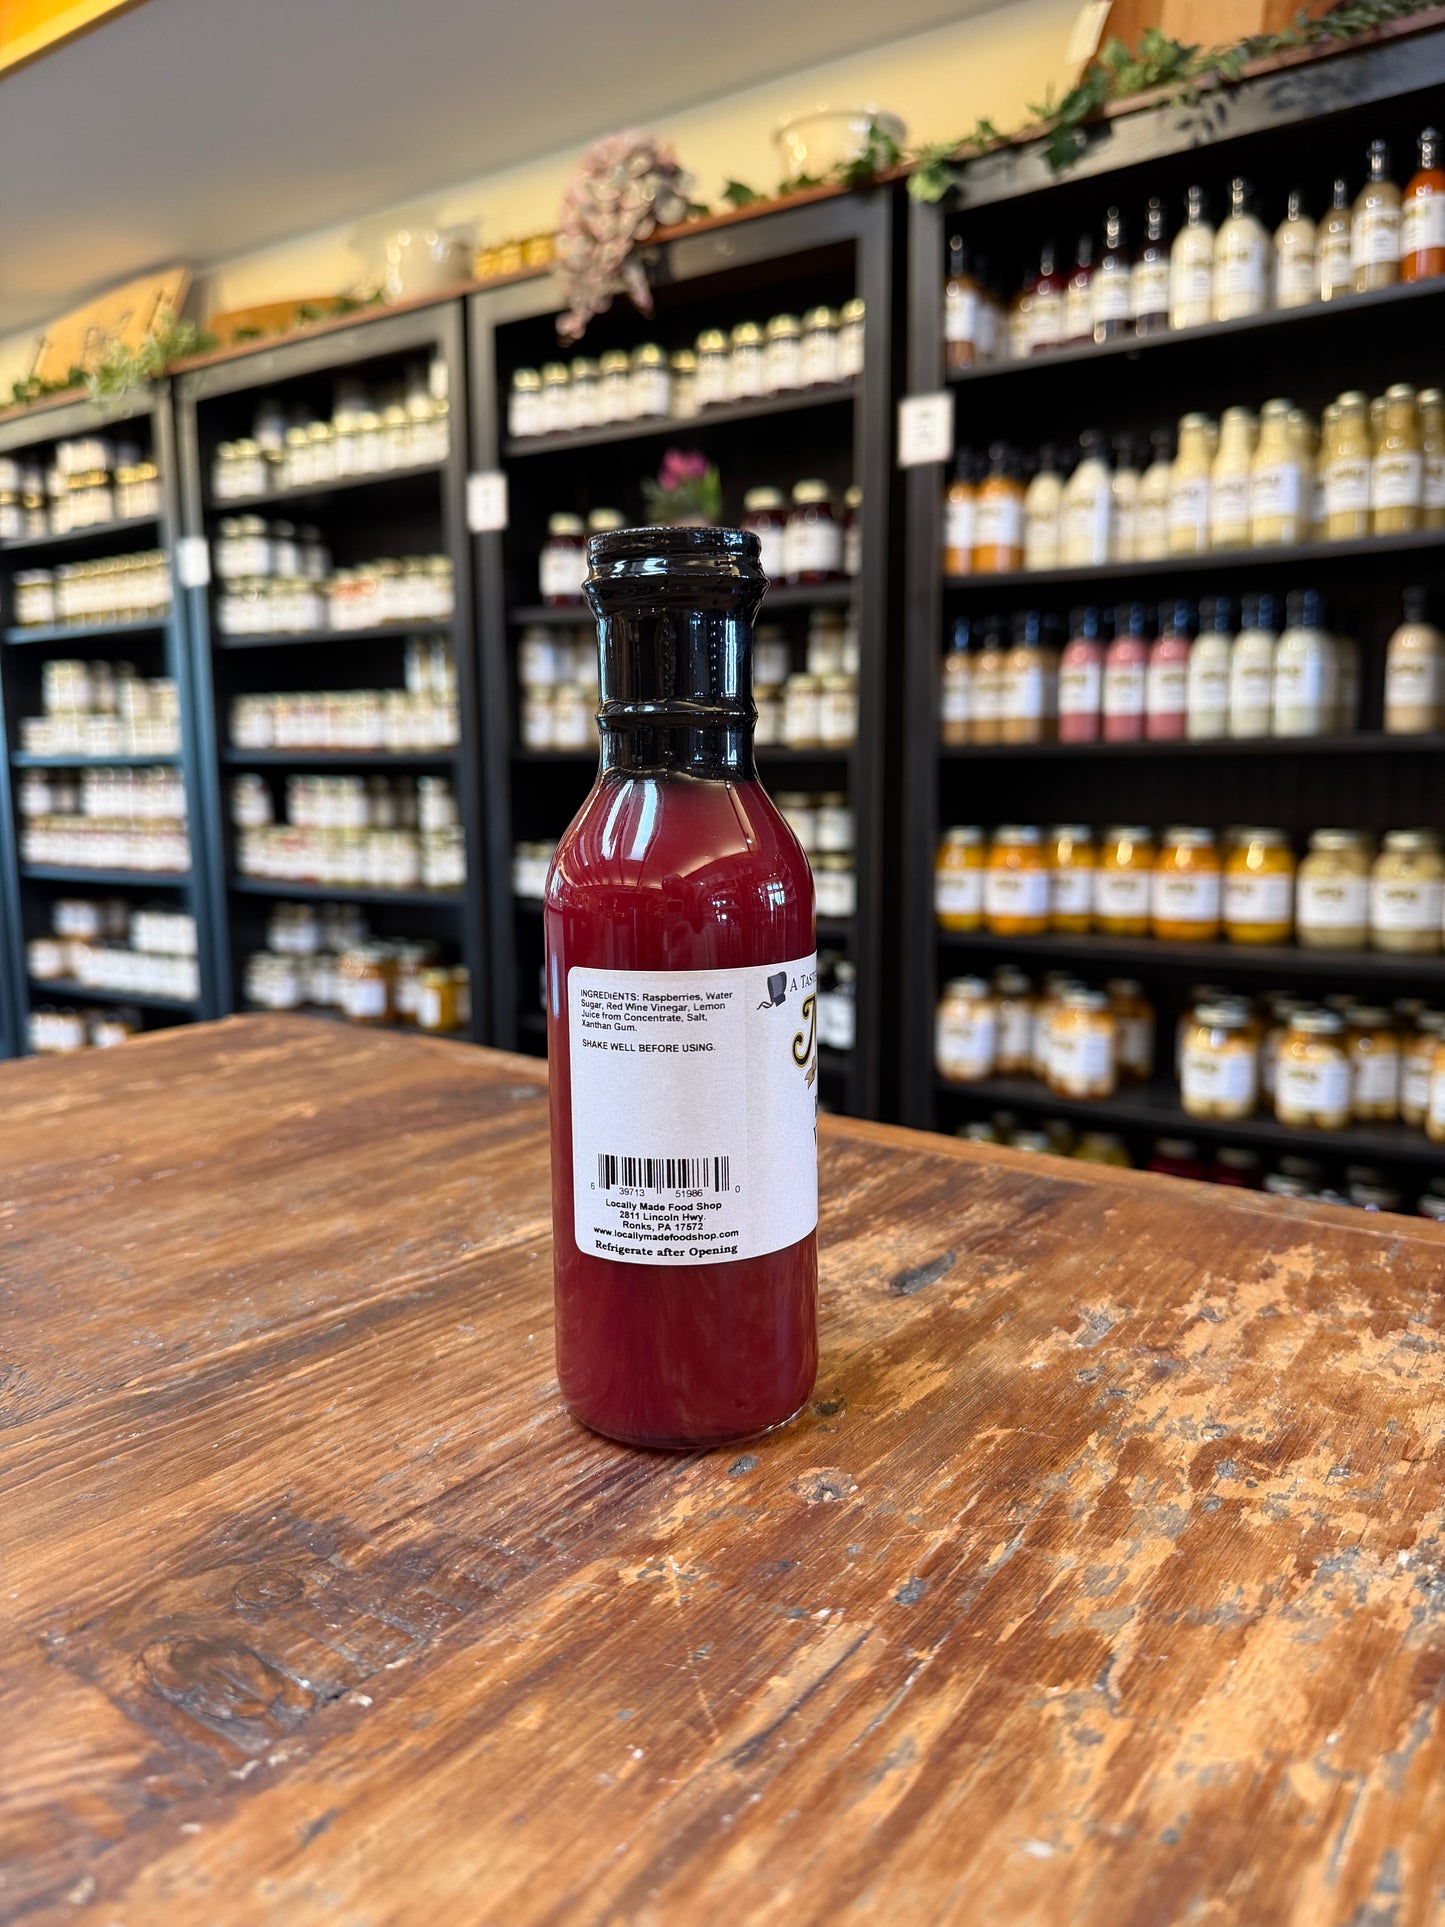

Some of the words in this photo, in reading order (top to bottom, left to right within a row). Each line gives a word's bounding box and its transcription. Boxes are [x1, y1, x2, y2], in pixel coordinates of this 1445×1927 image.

[790, 977, 797, 992] A
[643, 992, 703, 1003] Raspberries,
[581, 999, 604, 1010] Sugar,
[607, 1002, 622, 1010] Red
[625, 1003, 648, 1011] Wine
[651, 1004, 690, 1013] Vinegar,
[581, 1010, 600, 1018] Juice
[602, 1012, 621, 1020] from
[624, 1013, 684, 1022] Concentrate,
[687, 1013, 707, 1021] Salt,
[582, 1019, 611, 1030] Xanthan
[614, 1023, 637, 1031] Gum.
[582, 1039, 608, 1049] SHAKE
[611, 1043, 635, 1051] WELL
[639, 1044, 679, 1052] BEFORE
[682, 1043, 716, 1052] USING.
[591, 1182, 595, 1190] 6
[619, 1188, 645, 1196] 39713
[676, 1189, 703, 1197] 51986
[735, 1185, 740, 1193] 0
[606, 1199, 637, 1211] Locally
[669, 1203, 693, 1211] Food
[697, 1202, 722, 1210] Shop
[620, 1211, 639, 1219] 2811
[644, 1213, 679, 1221] Lincoln
[683, 1214, 706, 1222] Hwy.
[623, 1221, 654, 1231] Ronks,
[675, 1223, 703, 1231] 17572
[594, 1227, 738, 1241] www.locallymadefoodshop.com
[596, 1240, 653, 1255] Refrigerate
[657, 1248, 685, 1256] after
[689, 1245, 737, 1258] Opening
